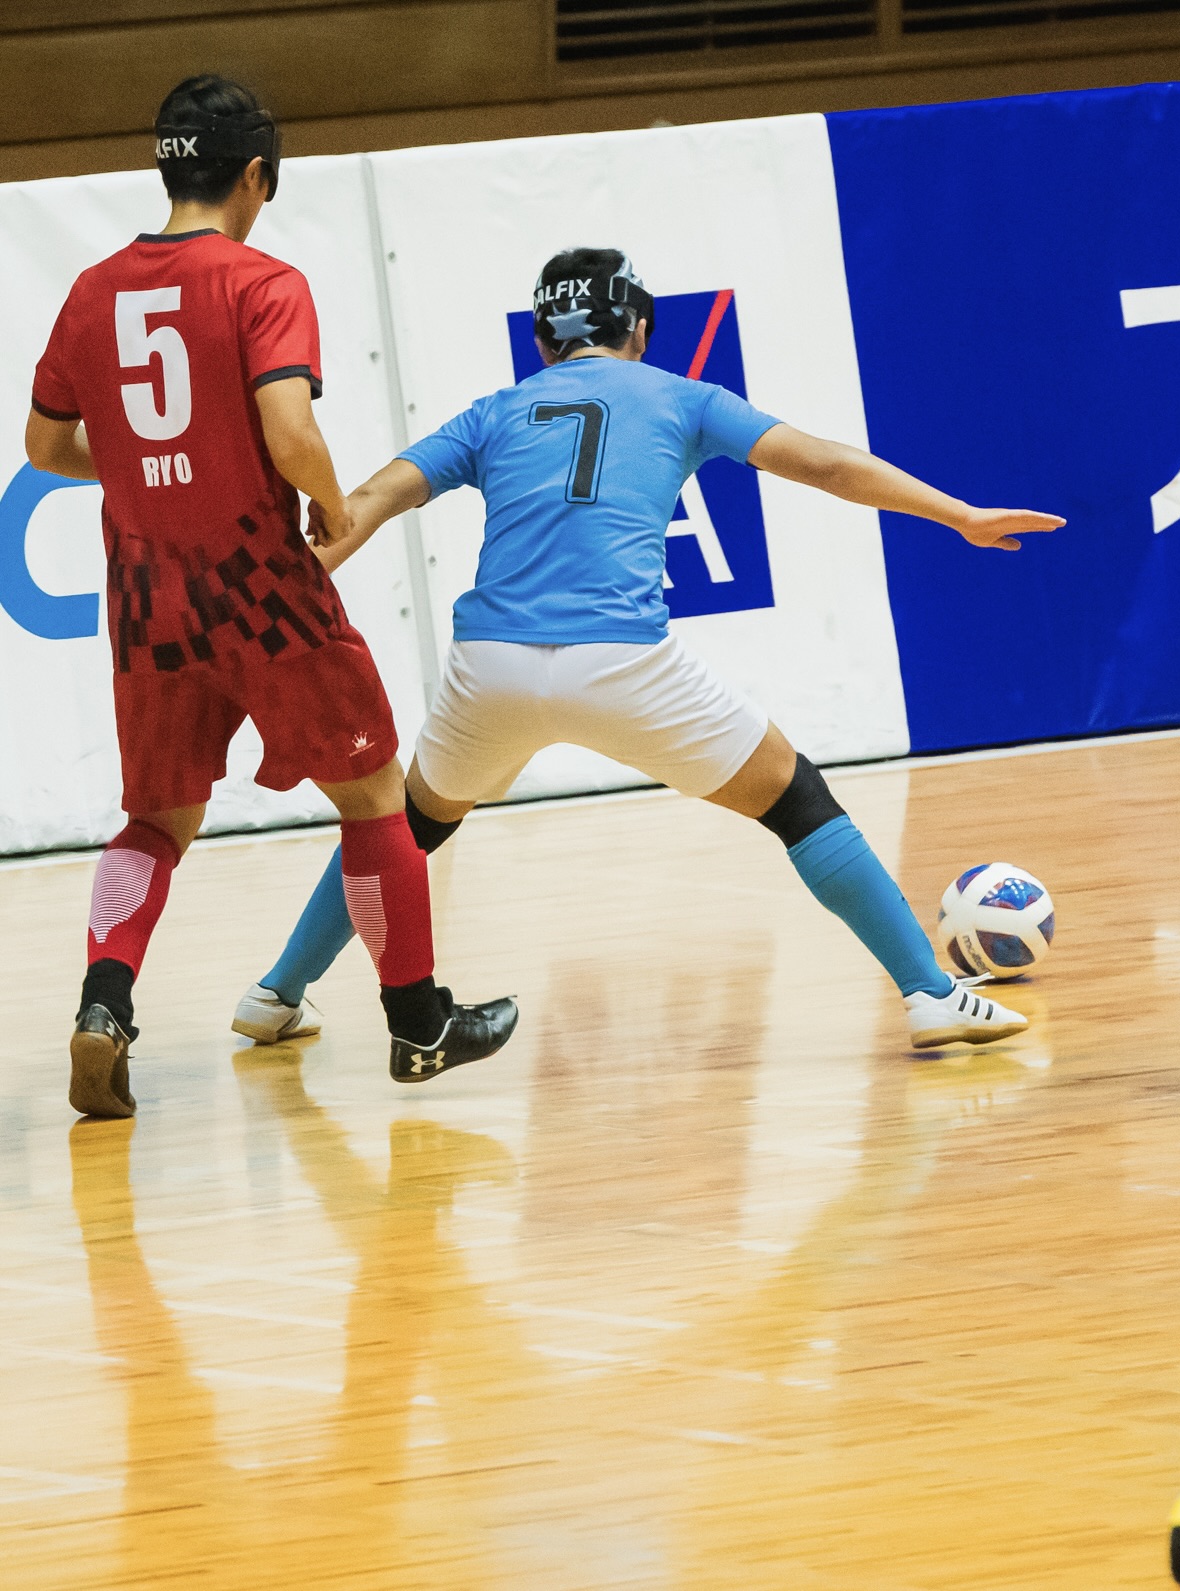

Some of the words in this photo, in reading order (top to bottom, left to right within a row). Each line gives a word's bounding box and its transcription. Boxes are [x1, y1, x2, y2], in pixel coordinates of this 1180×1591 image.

[155, 136, 199, 159] LFIX
[114, 285, 193, 441] 5
[141, 452, 193, 487] RYO
[528, 398, 610, 505] 7
